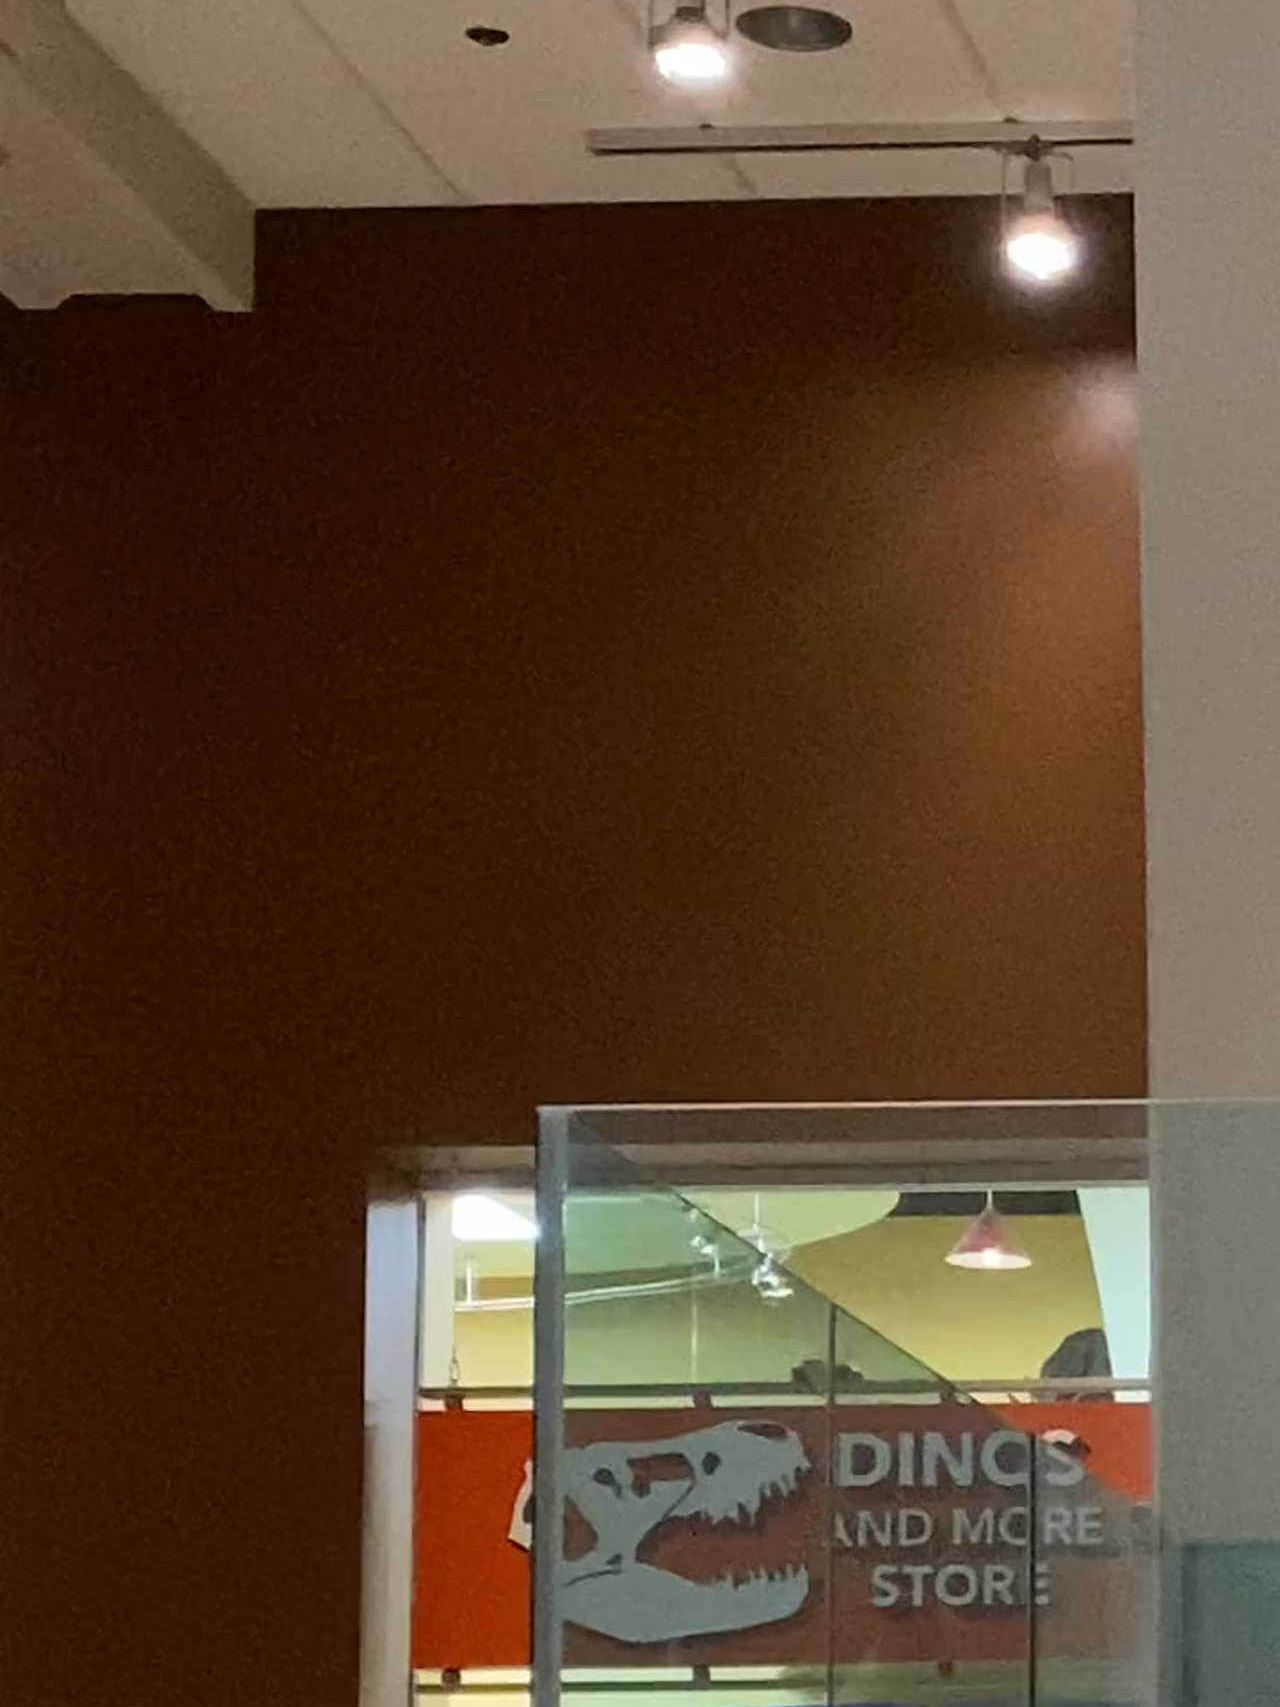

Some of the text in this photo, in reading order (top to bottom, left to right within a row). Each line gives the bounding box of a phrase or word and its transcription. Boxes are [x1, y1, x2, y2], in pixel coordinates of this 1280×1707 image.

[836, 1429, 1088, 1487] DINOS
[951, 1506, 1104, 1546] MORE
[870, 1563, 1050, 1607] STORE
